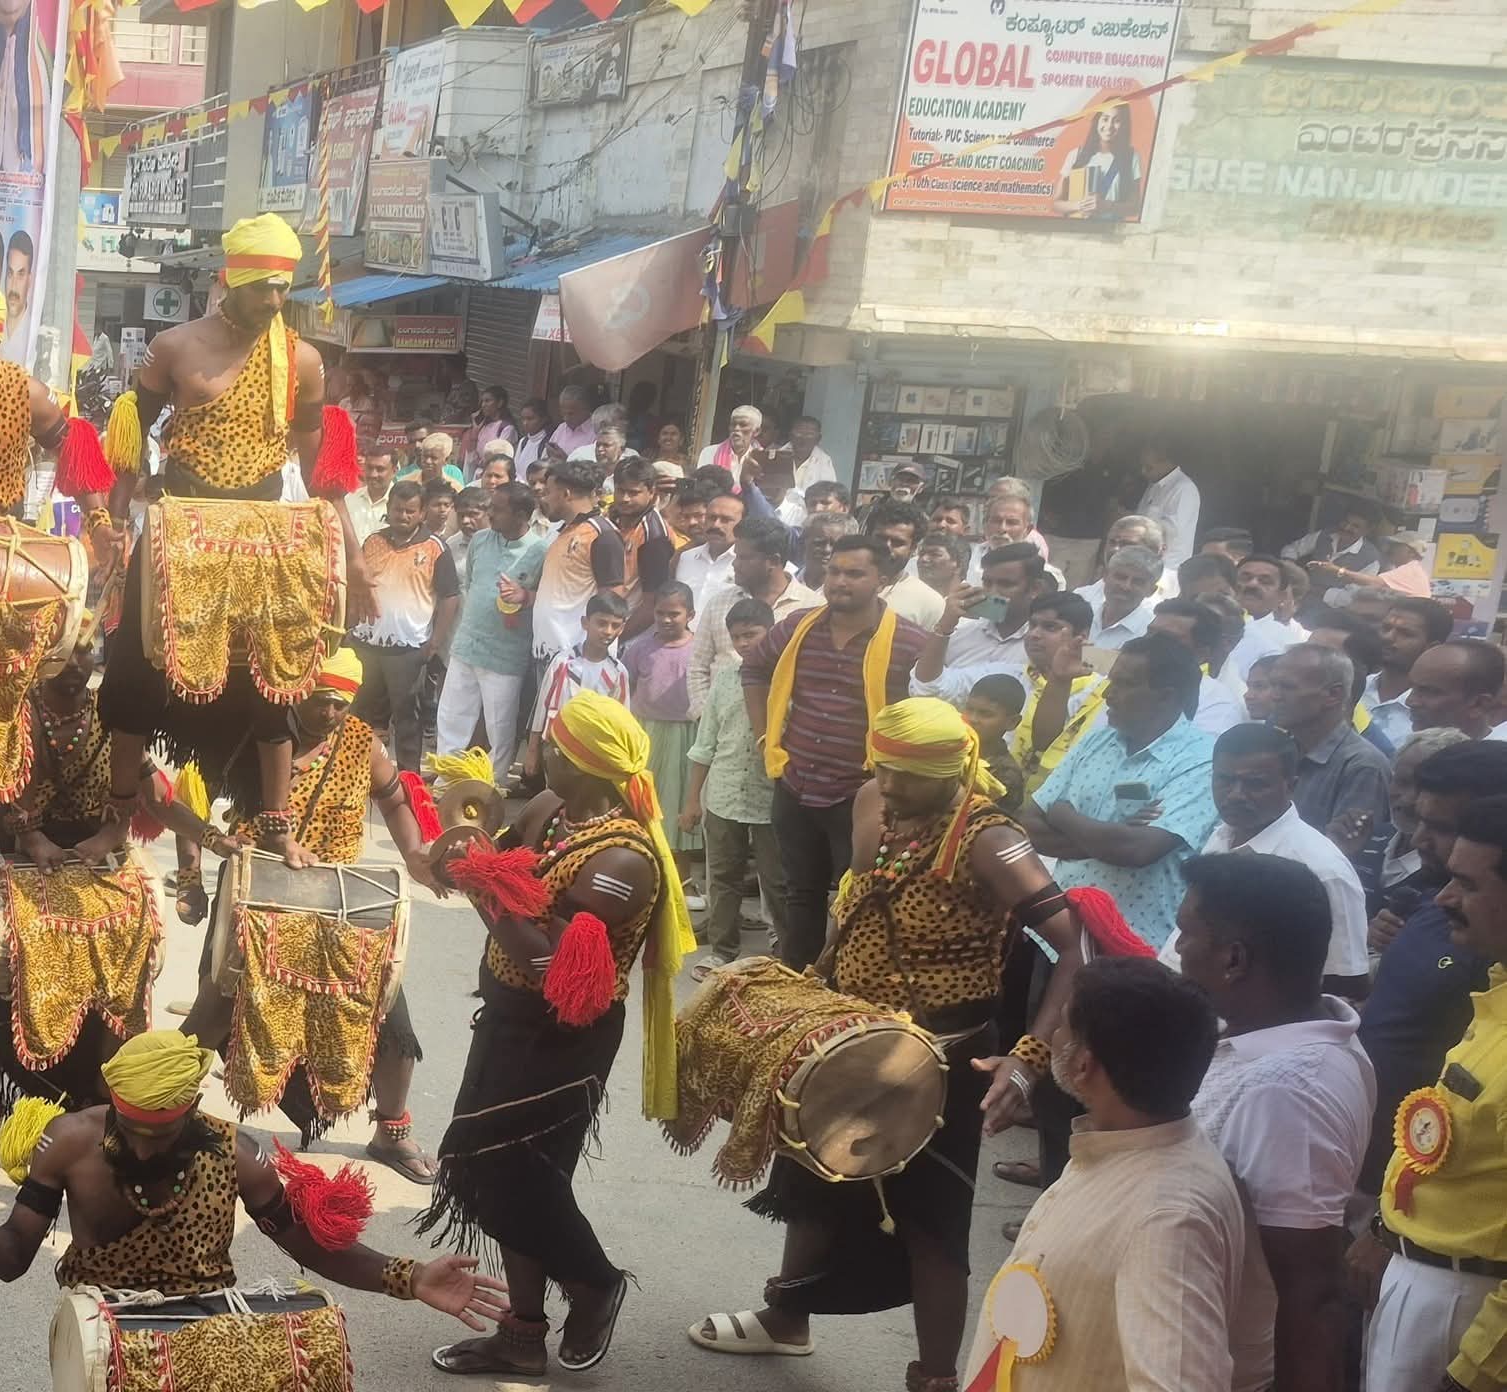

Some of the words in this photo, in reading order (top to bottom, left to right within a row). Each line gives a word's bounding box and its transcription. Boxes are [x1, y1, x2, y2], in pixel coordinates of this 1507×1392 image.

[913, 39, 1034, 89] GLOBAL
[1046, 49, 1103, 65] COMPUTER
[1104, 52, 1165, 68] EDUCATION
[1041, 73, 1084, 87] SPOKEN
[1085, 75, 1134, 90] ENGLISH
[908, 97, 971, 118] EDUCATION
[972, 101, 1026, 121] ACADEMY
[944, 128, 961, 143] PUC
[955, 154, 973, 168] AND
[974, 155, 998, 169] KCET
[999, 156, 1044, 171] COACHING
[1170, 154, 1266, 195] SREE
[984, 179, 1000, 193] and
[1001, 180, 1054, 197] mathematics)
